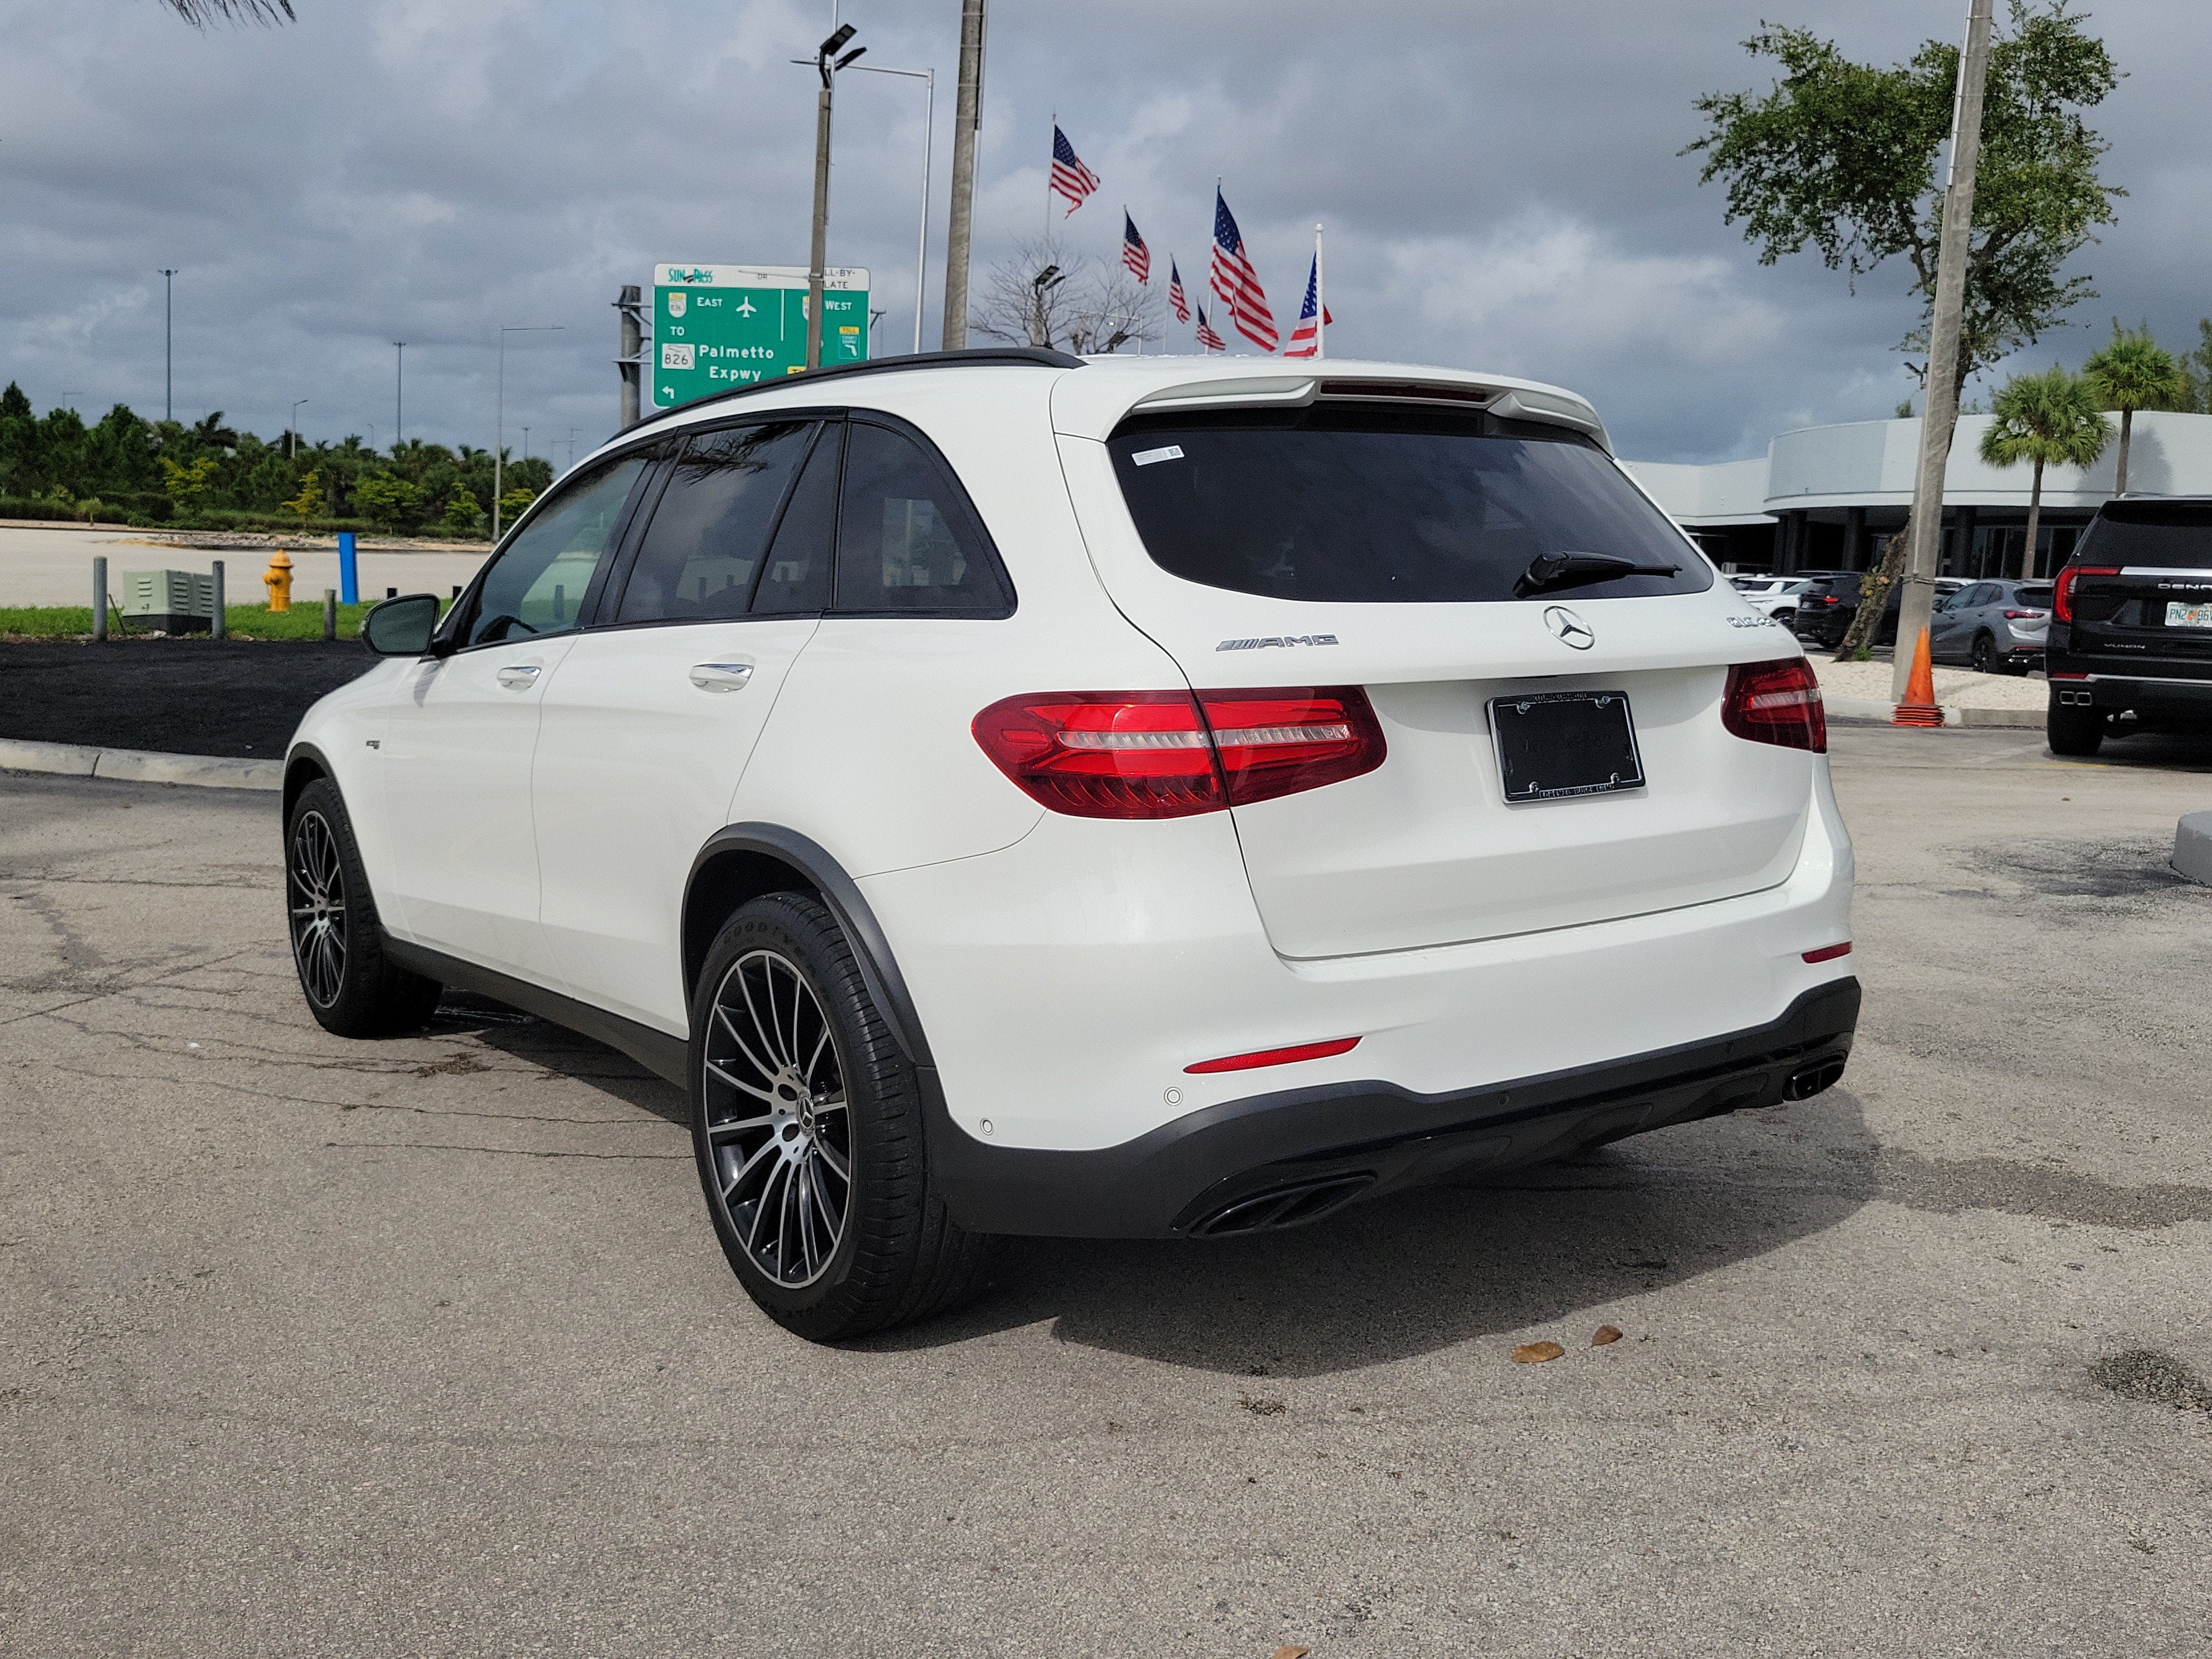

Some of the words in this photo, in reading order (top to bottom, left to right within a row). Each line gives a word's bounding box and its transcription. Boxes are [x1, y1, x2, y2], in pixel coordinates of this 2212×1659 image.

[697, 297, 723, 307] EAST
[825, 300, 852, 311] WEST
[670, 326, 685, 336] TO
[699, 345, 774, 359] Palmetto
[664, 354, 689, 365] 826
[709, 365, 761, 382] Expwy
[2197, 610, 2212, 621] 96
[1257, 634, 1339, 649] AMG
